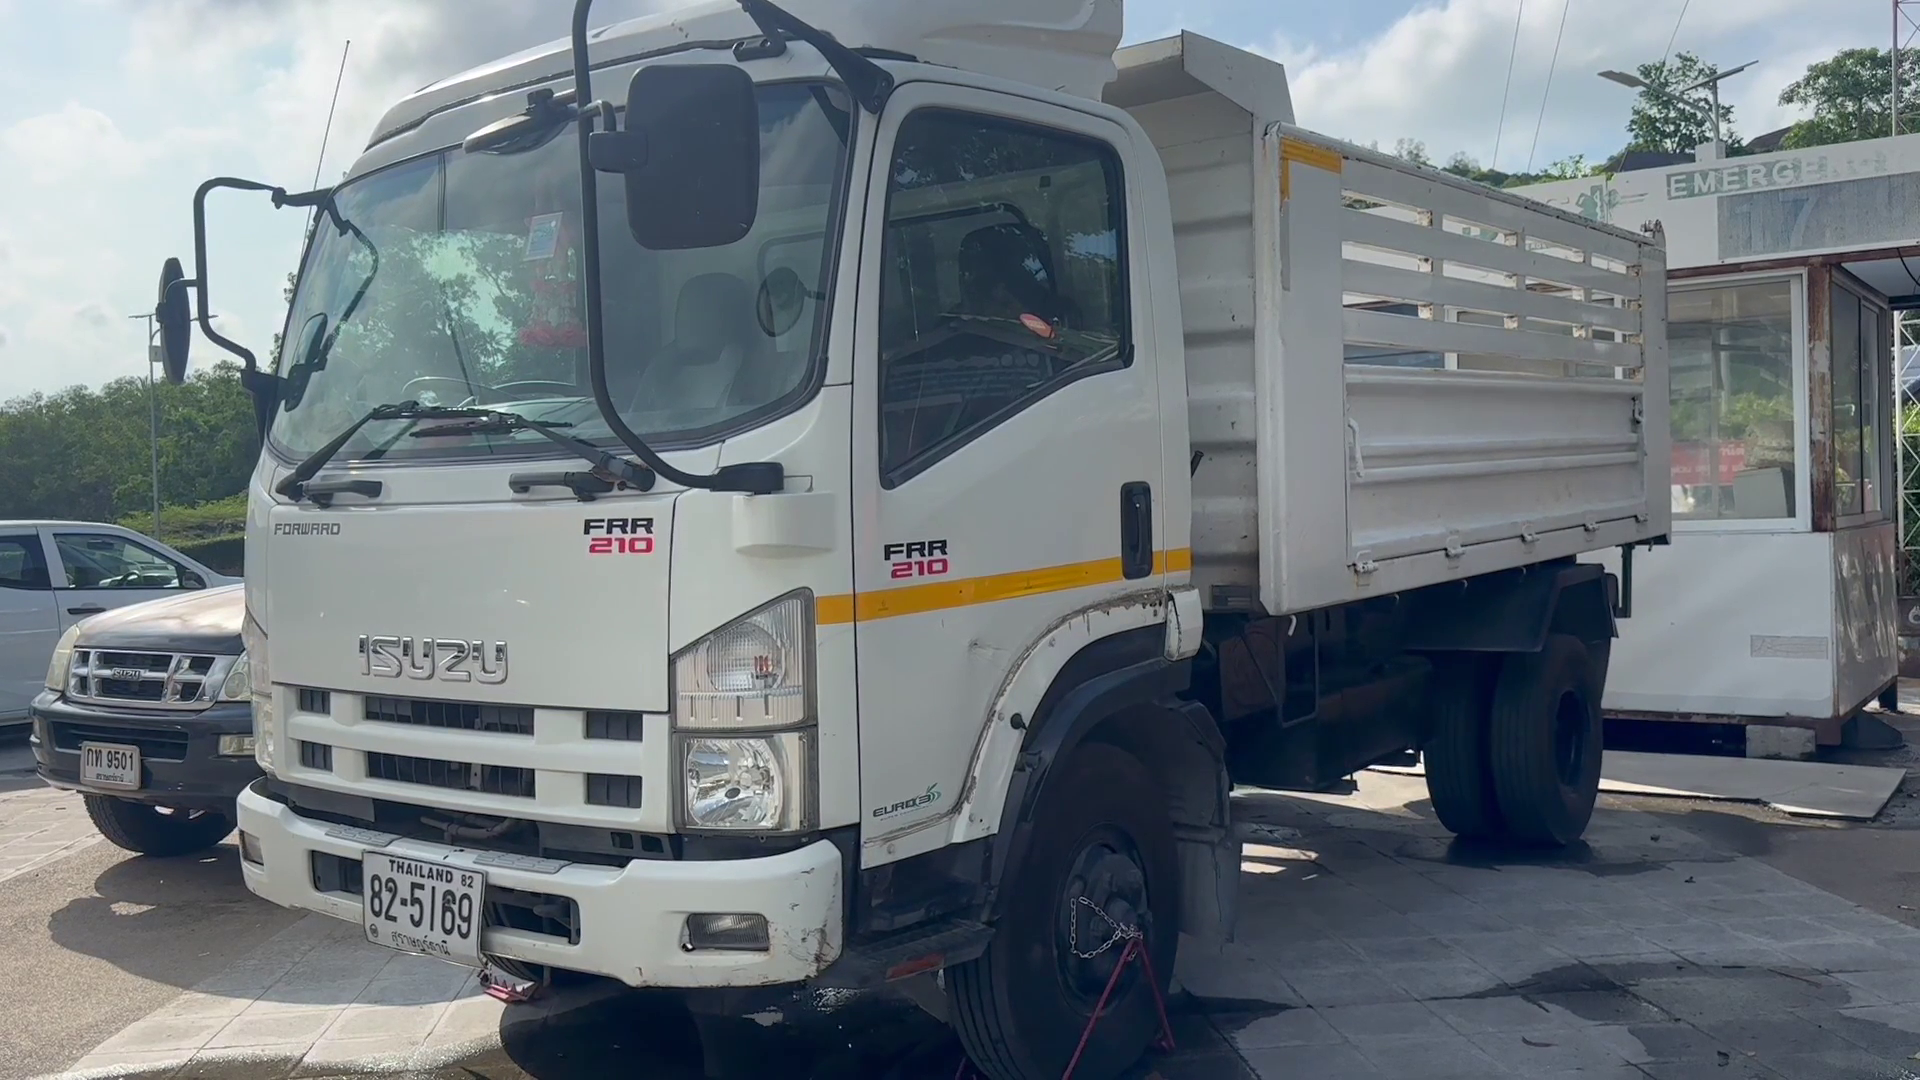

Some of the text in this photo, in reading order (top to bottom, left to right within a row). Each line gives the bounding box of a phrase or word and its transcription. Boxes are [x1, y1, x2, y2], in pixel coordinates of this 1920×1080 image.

[273, 522, 341, 537] FORWARD
[583, 517, 655, 536] FRR
[588, 537, 654, 555] 210
[883, 539, 948, 561] FRR
[891, 558, 949, 579] 210
[358, 633, 508, 685] ISUZU
[106, 750, 134, 772] 9501
[388, 859, 475, 889] THAILAND 82
[369, 873, 474, 940] 82-5169
